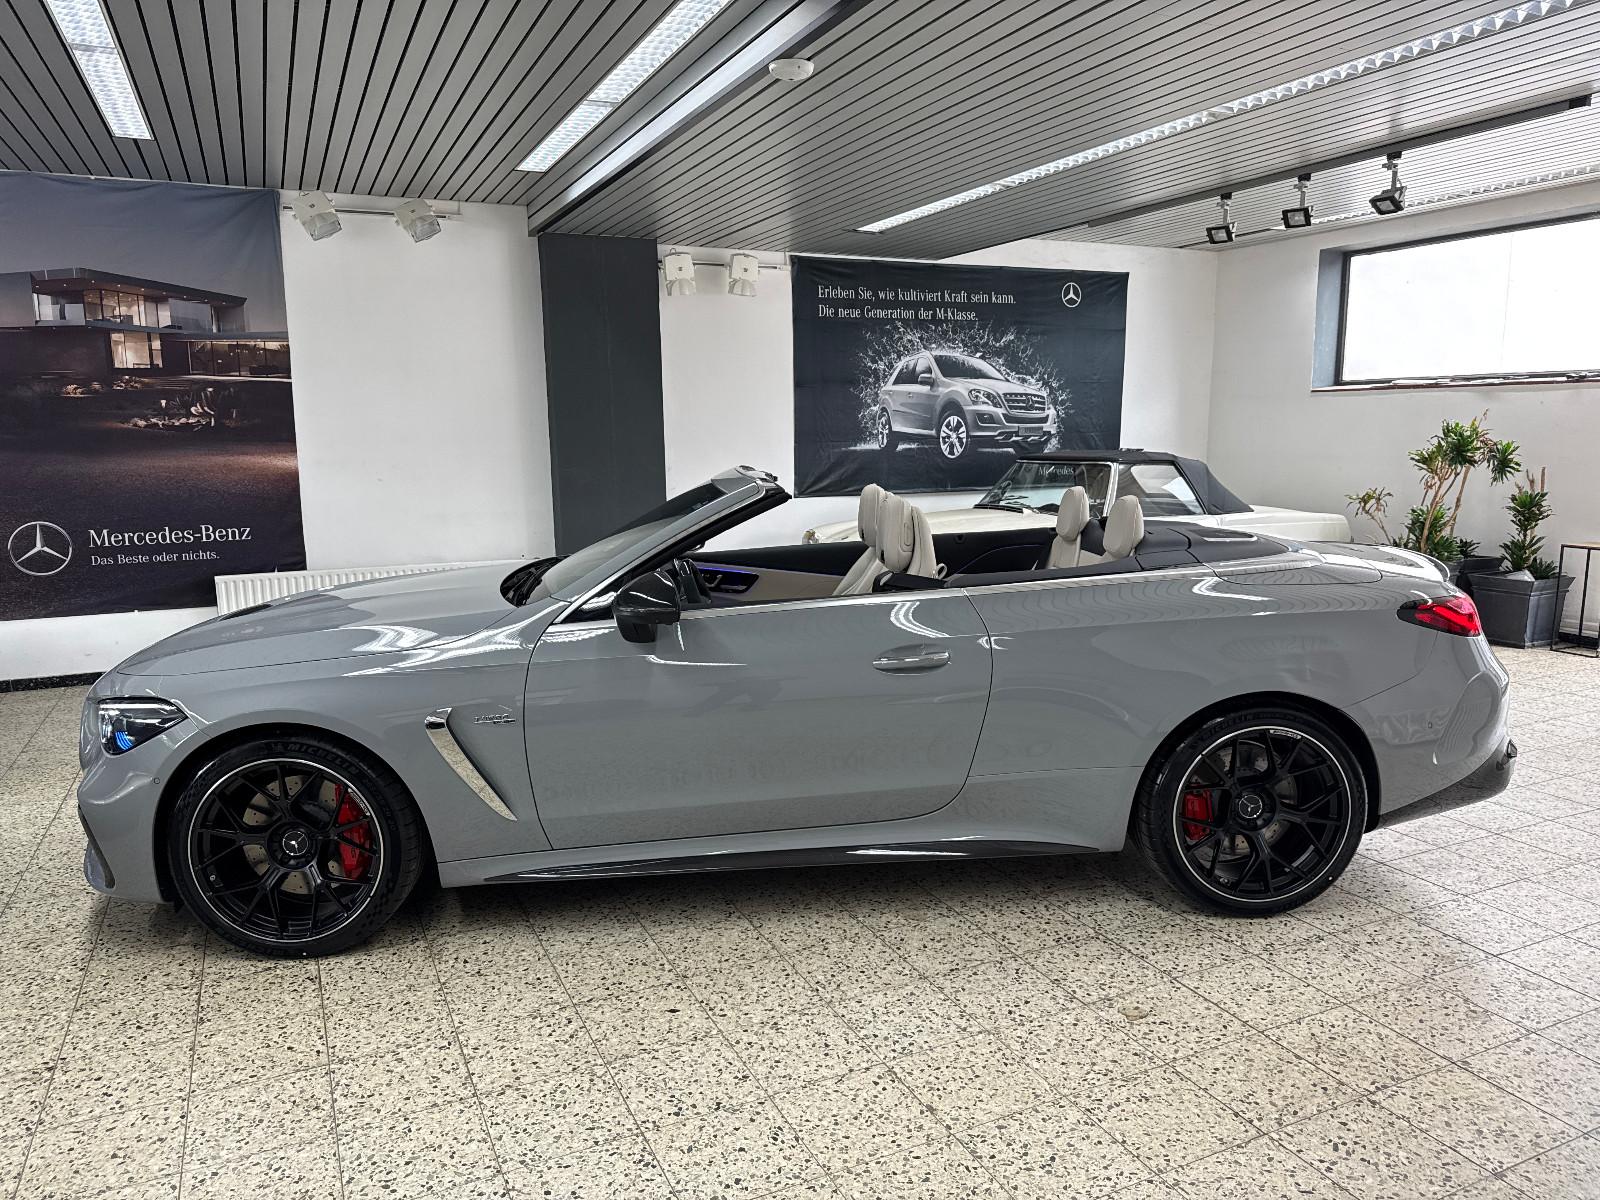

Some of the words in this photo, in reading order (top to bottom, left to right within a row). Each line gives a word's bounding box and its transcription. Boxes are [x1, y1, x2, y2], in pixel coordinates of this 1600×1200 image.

[818, 285, 855, 299] Erleben
[858, 286, 875, 302] Sie,
[878, 288, 895, 300] wie
[898, 288, 941, 302] kultiviert
[944, 290, 967, 302] Kraft
[970, 291, 989, 303] sein
[991, 292, 1016, 304] kann.
[818, 304, 835, 317] Die
[838, 307, 861, 318] neue
[864, 305, 915, 319] Generation
[918, 307, 933, 319] der
[936, 308, 979, 321] M-Klasse.
[88, 525, 251, 547] Mercedes-Benz
[91, 555, 114, 566] Das
[117, 554, 149, 564] Beste
[152, 552, 179, 562] oder
[182, 550, 220, 561] nichts.
